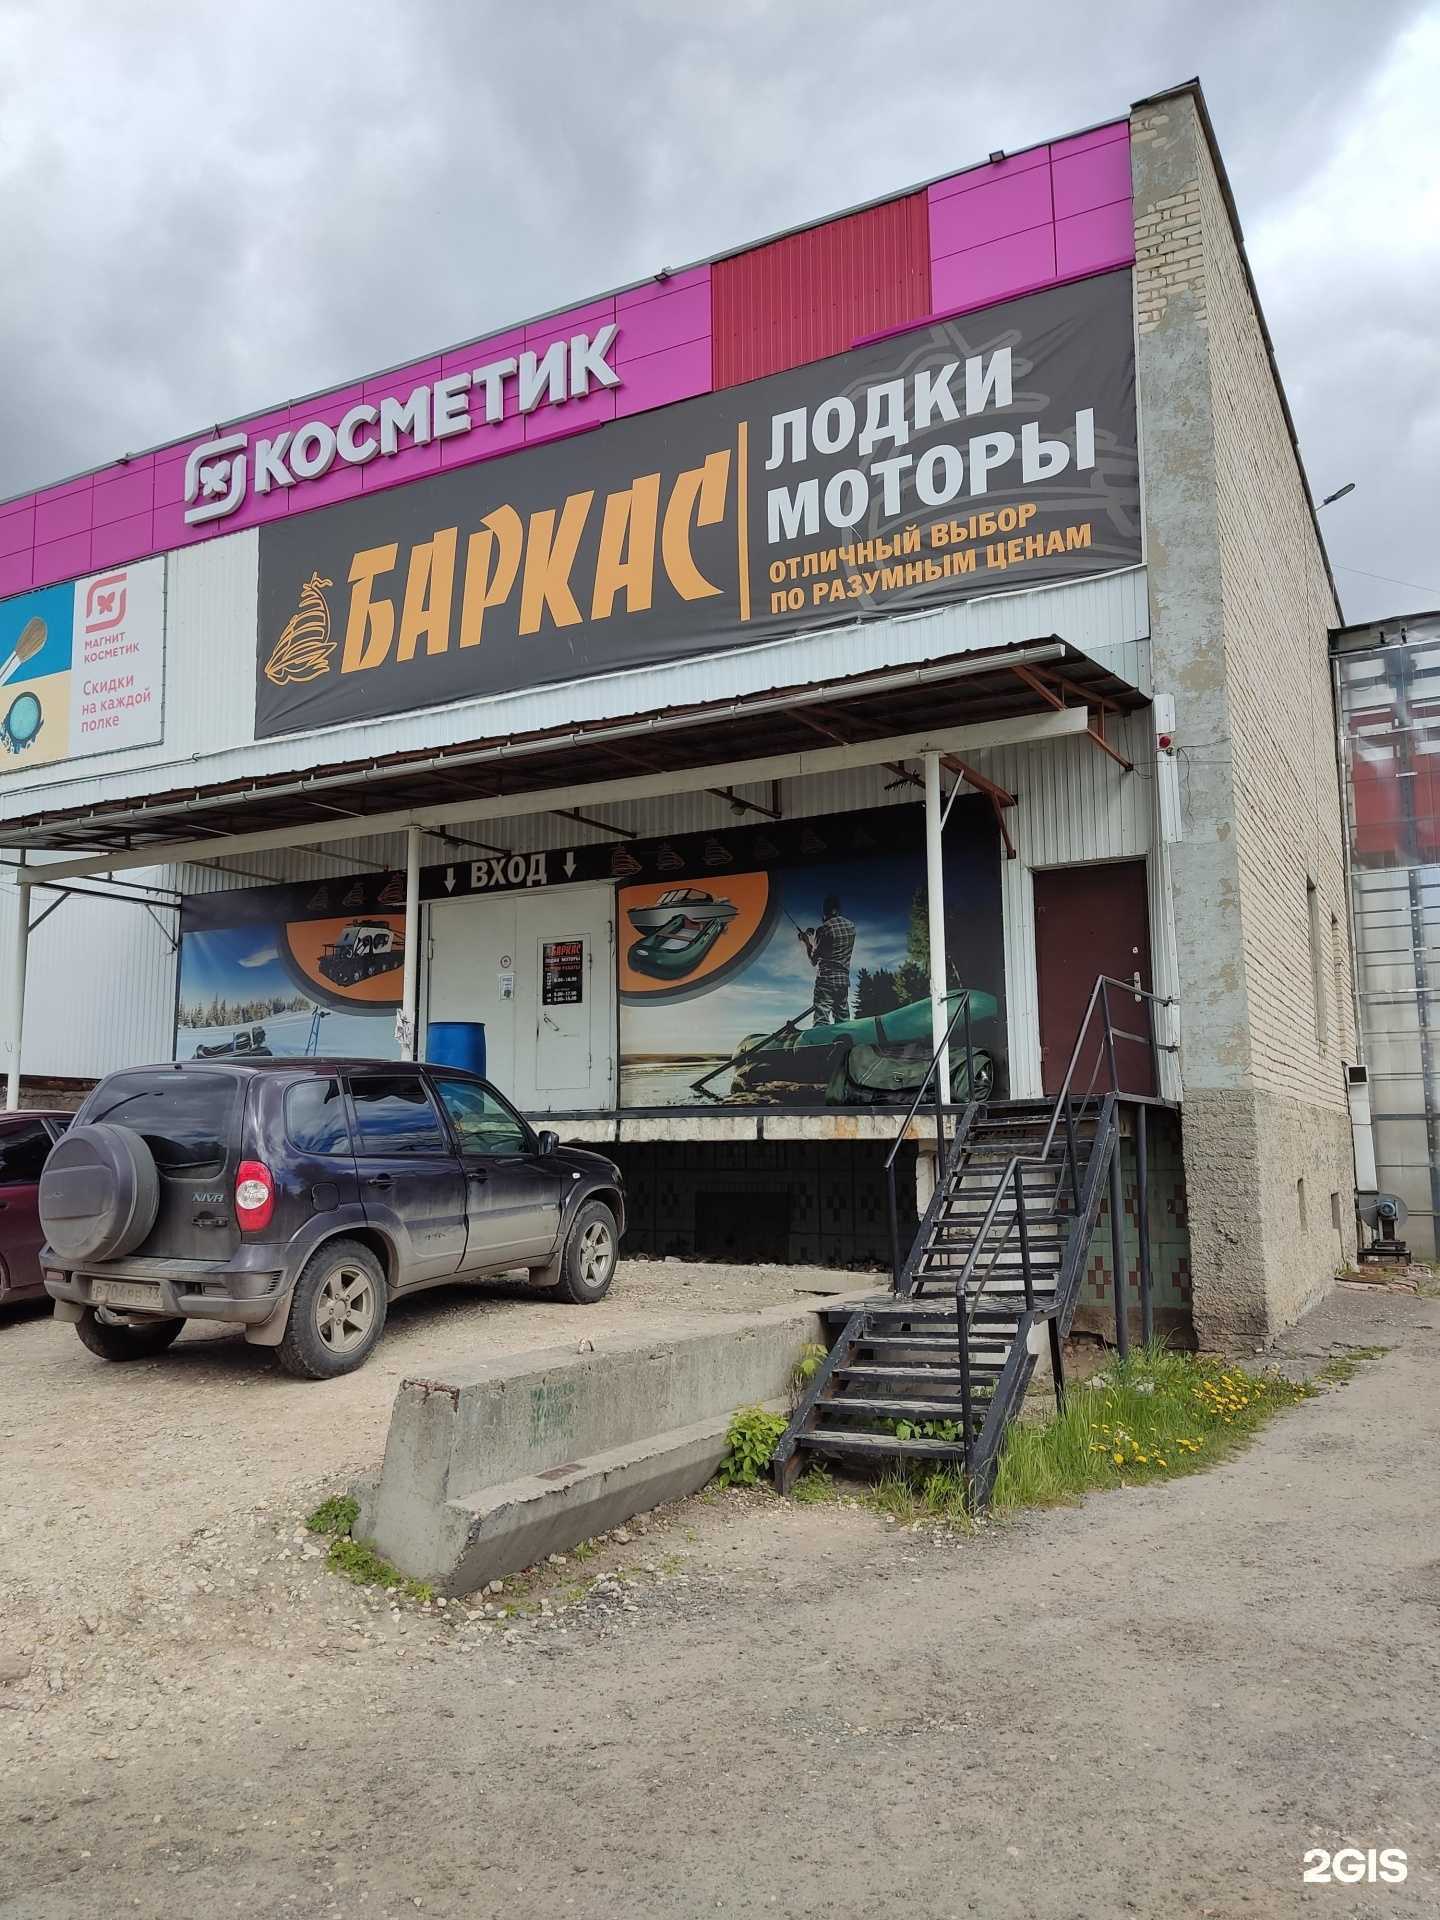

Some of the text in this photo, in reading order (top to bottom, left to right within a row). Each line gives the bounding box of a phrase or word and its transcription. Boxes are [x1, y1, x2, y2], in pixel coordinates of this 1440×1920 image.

[254, 323, 623, 494] КОСМЕТИК
[765, 346, 1014, 470] ЛОДКИ
[767, 406, 1096, 544] МОТОРЫ
[340, 449, 732, 674] БАРКАС
[768, 503, 1038, 584] ОТЛИЧНЫЙ ВЫБОР
[771, 522, 1093, 614] ПО РАЗУМНЫМ ЦЕНАМ
[84, 642, 140, 664] КОСМЕТИК
[85, 632, 126, 650] МАГНИТ
[82, 687, 151, 716] на каждой
[83, 675, 134, 695] Скидки
[81, 714, 120, 733] полке
[470, 853, 548, 889] ВХОД
[191, 1192, 225, 1202] NIVA
